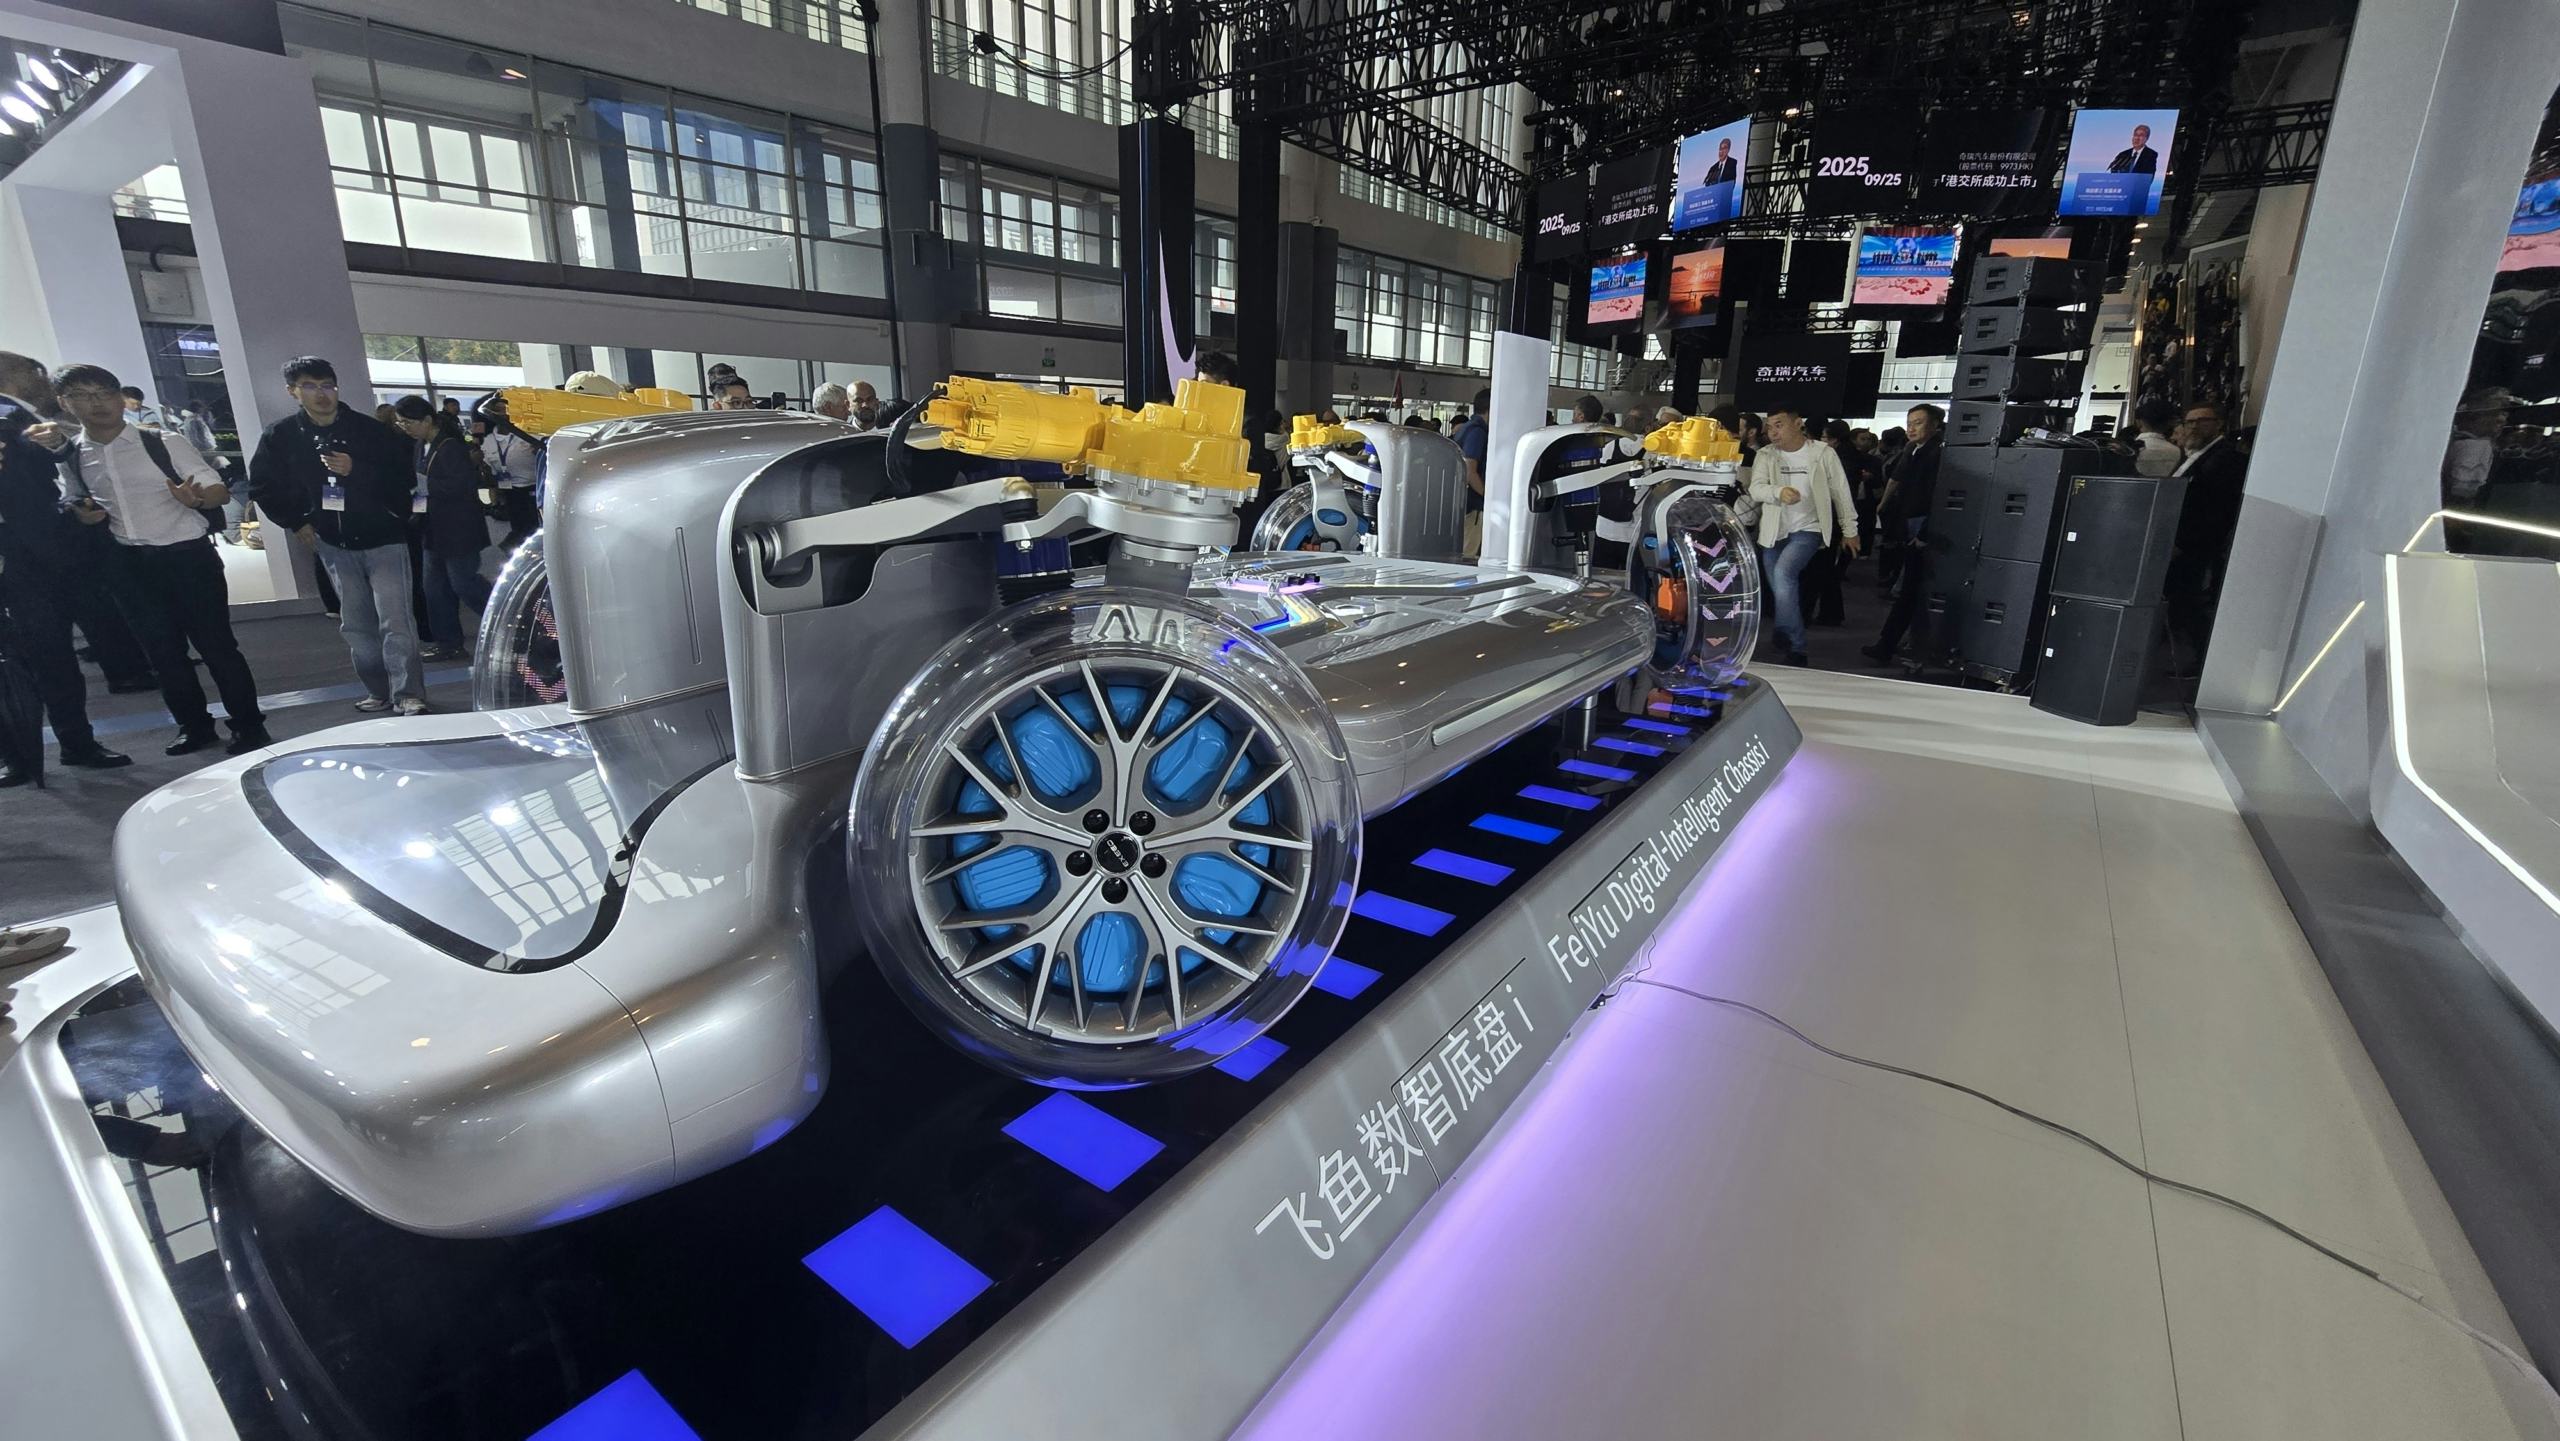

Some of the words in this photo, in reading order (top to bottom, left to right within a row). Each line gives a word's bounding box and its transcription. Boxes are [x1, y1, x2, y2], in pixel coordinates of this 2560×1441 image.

[1817, 156, 1869, 176] 2025
[1864, 173, 1902, 186] 09/25
[1539, 213, 1565, 234] 2025
[1561, 222, 1580, 236] 09/25
[1756, 365, 1827, 377] 奇瑞汽车
[1106, 839, 1129, 868] EXEED
[1547, 905, 1620, 983] FeiYu
[1607, 777, 1733, 914] Digital-Intelligent
[1723, 742, 1766, 793] Chassis
[1254, 1000, 1523, 1260] 飞鱼数智底盘
[1506, 983, 1534, 1031] i
